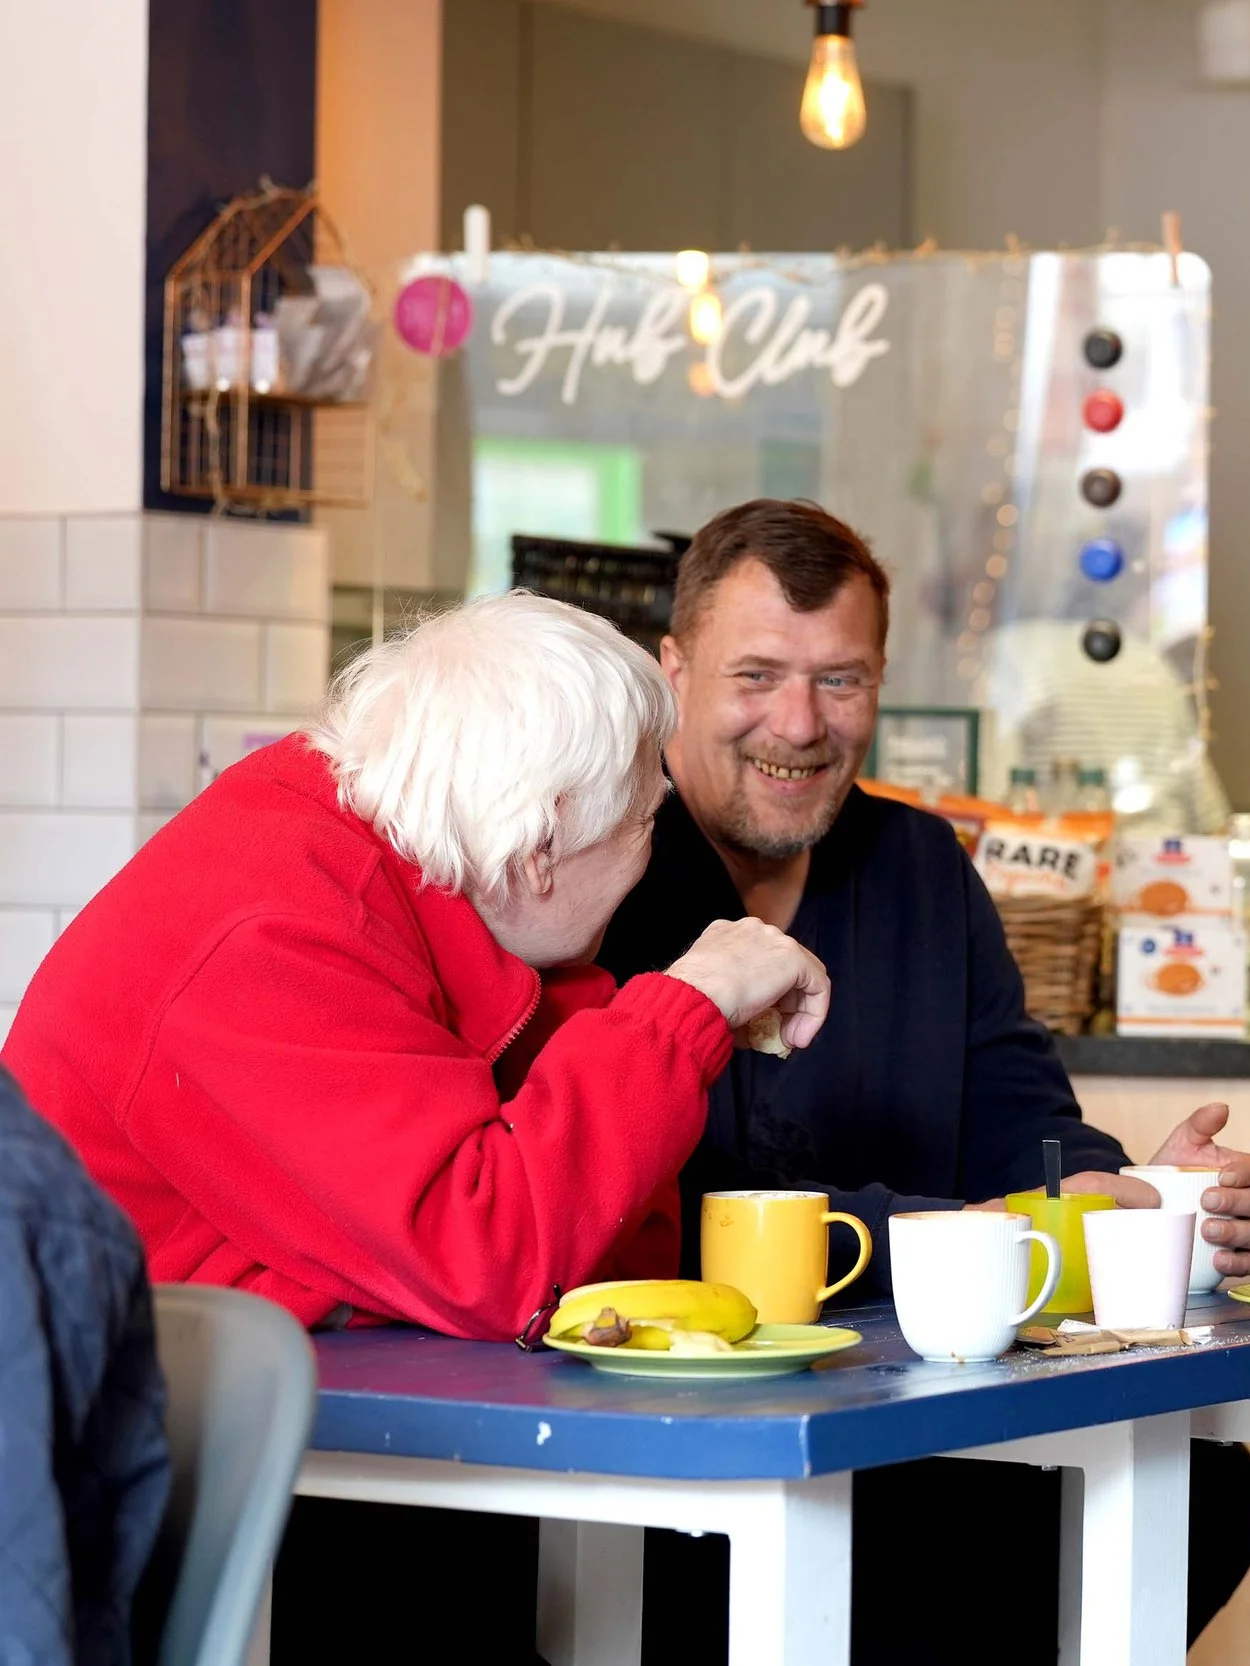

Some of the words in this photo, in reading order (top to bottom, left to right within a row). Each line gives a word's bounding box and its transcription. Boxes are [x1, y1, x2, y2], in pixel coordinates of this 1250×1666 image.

[492, 283, 687, 404] Hub
[705, 282, 890, 399] Club
[985, 838, 1082, 881] RARE
